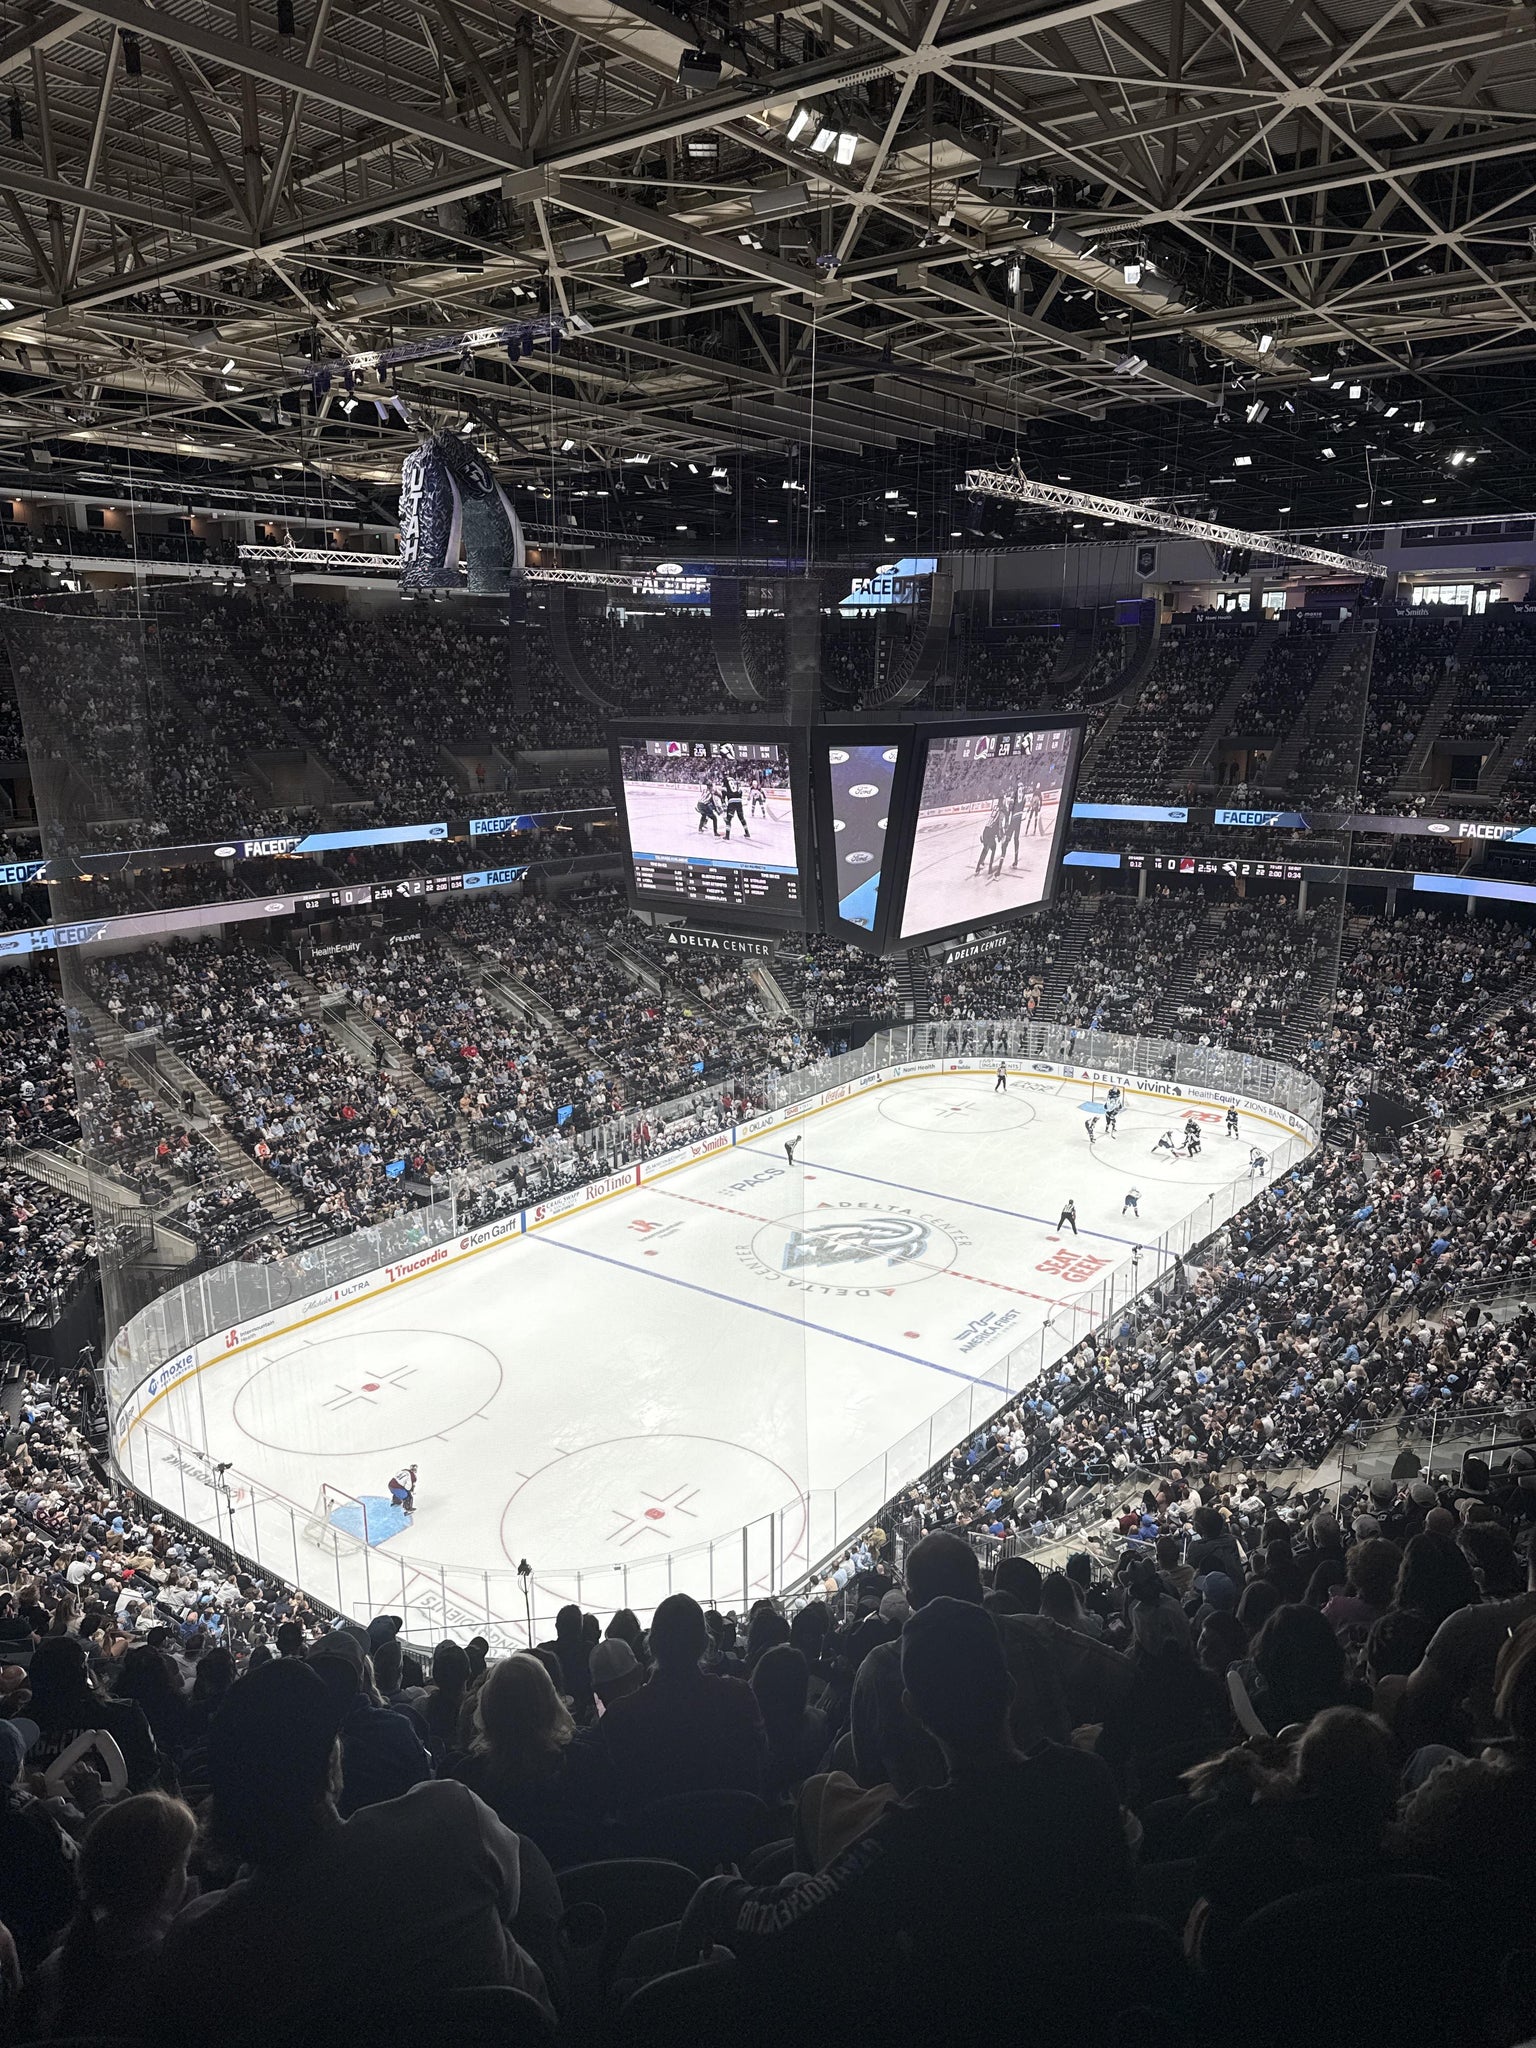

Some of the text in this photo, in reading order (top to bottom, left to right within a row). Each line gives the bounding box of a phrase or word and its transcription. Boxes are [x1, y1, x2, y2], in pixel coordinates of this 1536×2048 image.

[404, 467, 425, 562] UTAH
[1405, 608, 1429, 616] Smith's
[852, 785, 875, 796] Ford
[475, 819, 517, 833] FACEOFF
[1223, 811, 1278, 825] FACEOFF
[848, 852, 871, 863] Ford
[1167, 859, 1176, 870] 0
[487, 868, 527, 884] FACEOFF
[1198, 864, 1217, 873] 2:54
[1241, 865, 1249, 875] 2
[1268, 870, 1282, 878] 2:00
[374, 889, 393, 900] 2:54
[413, 883, 421, 893] 2
[436, 883, 447, 891] 2:00
[305, 901, 319, 909] 0:12
[345, 891, 353, 903] 0
[311, 942, 361, 958] HealthEquity
[680, 934, 769, 955] DELTA CENTER
[955, 937, 1007, 960] DELTA CENTER
[918, 1063, 935, 1071] Health
[860, 1075, 876, 1086] Layton
[1093, 1072, 1131, 1086] DELTA
[1188, 1088, 1240, 1106] HealthEquity
[1244, 1101, 1287, 1122] ZIONS BANK
[749, 1116, 774, 1133] OKLAND
[702, 1135, 728, 1153] Smith's
[730, 1167, 785, 1193] PACS
[839, 1201, 973, 1247] DELTA CENTER
[470, 1218, 517, 1247] Ken Garff
[395, 1249, 448, 1277] Trucordia
[1035, 1248, 1082, 1276] SEAT
[1061, 1254, 1114, 1283] GEEK
[735, 1244, 871, 1298] DELTA CENTER
[341, 1280, 370, 1297] ULTRA
[240, 1320, 275, 1338] Intermountain
[959, 1326, 1001, 1354] AMERICA
[993, 1309, 1021, 1327] FIRST
[240, 1333, 257, 1343] Health
[160, 1354, 193, 1383] moxie
